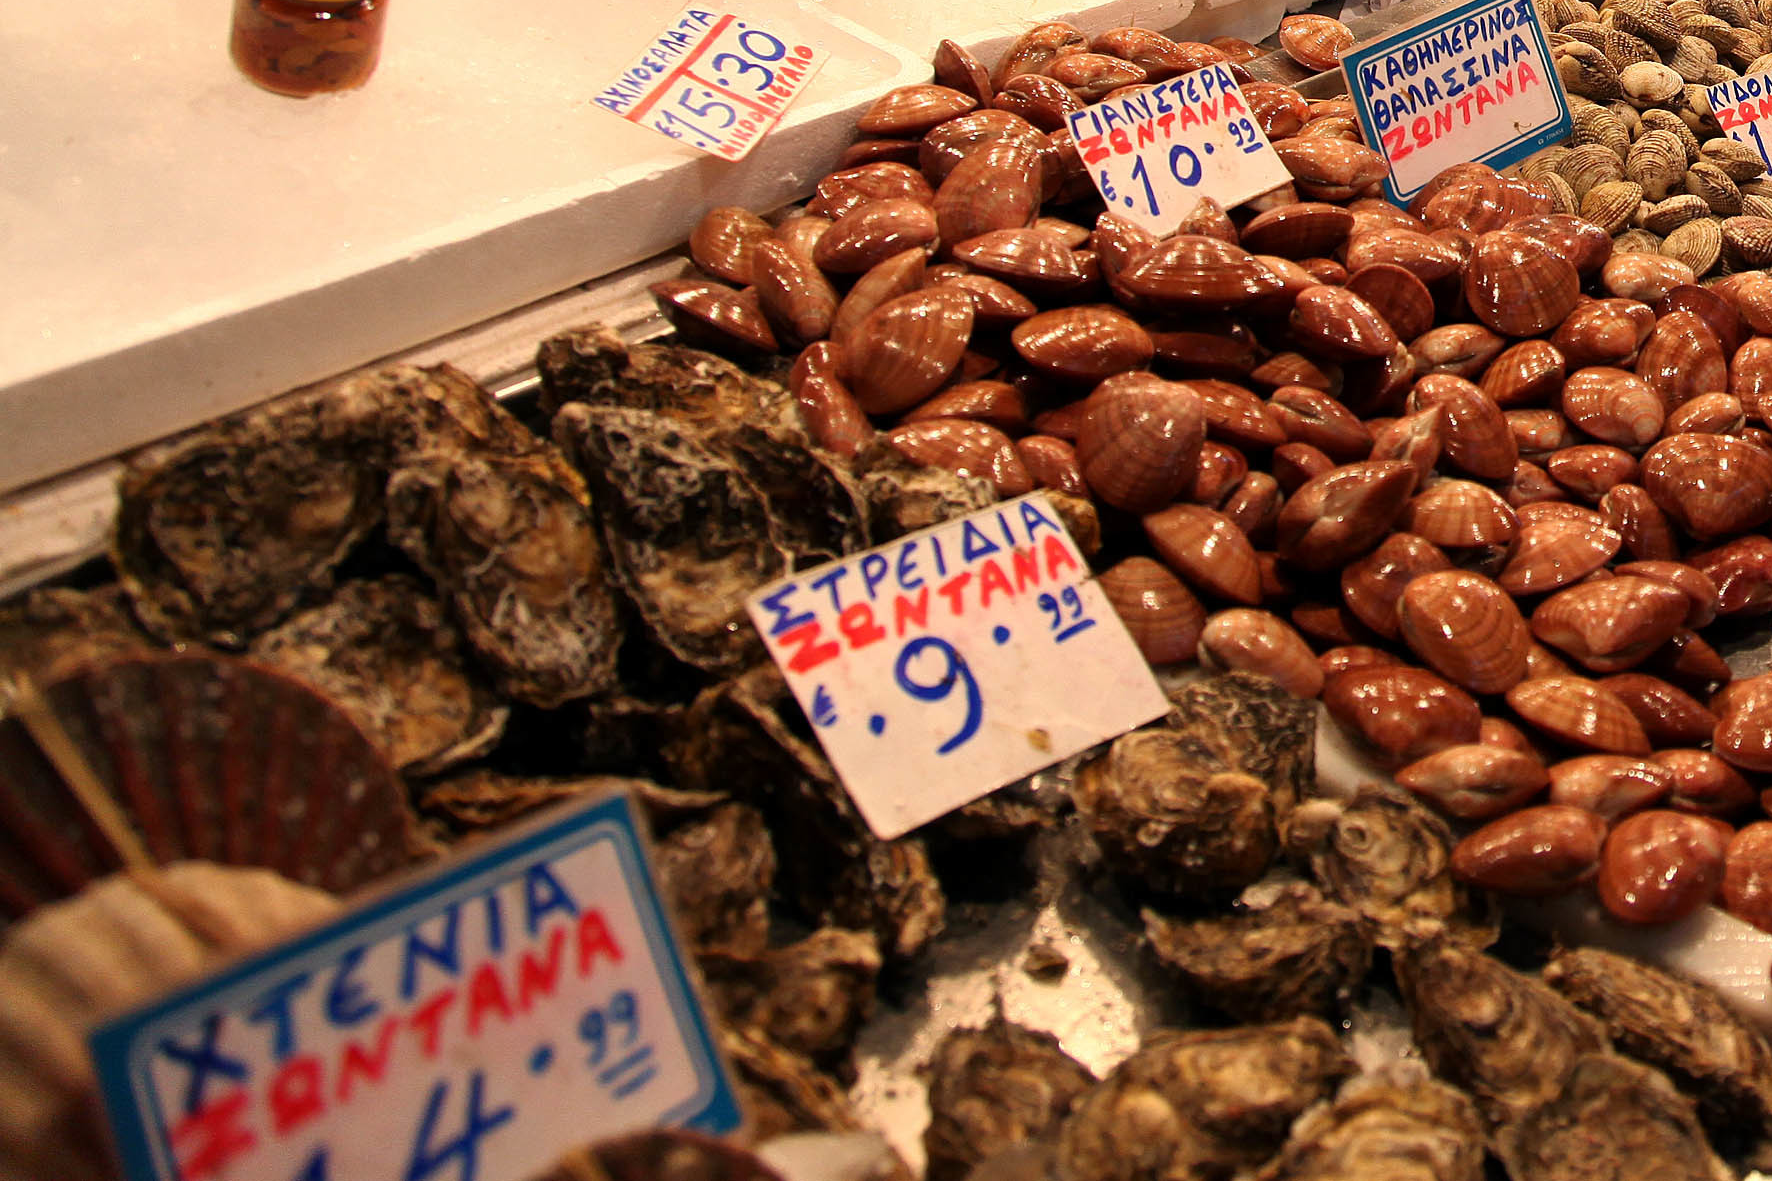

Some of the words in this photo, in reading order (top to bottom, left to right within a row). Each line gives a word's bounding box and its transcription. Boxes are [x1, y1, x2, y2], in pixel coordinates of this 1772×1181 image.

[594, 8, 716, 113] ΑΧΙΝΟΣΑΛΑΤΑ
[758, 44, 814, 110] ΜΕΓΑΛΟ
[1069, 65, 1237, 140] ΓΙΑΛΥΣΤΕΡΑ
[1373, 33, 1531, 130] ΘΑΛΑΣΣΙΝΑ
[1382, 60, 1540, 162] ΖΩΝΤΑΝΑ
[718, 109, 767, 158] ΜΙΚΡΟ
[1079, 92, 1246, 164] ΖΩΝΤΑΝΑ
[760, 500, 1062, 636] ΣΤΡΕΙΔΙΑ
[777, 533, 1080, 676] ΖΩΝΤΑΝΑ
[160, 860, 581, 1112] ΧΤΕΝΙΑ
[170, 906, 624, 1181] ΖΩΝΤΑΝΑ
